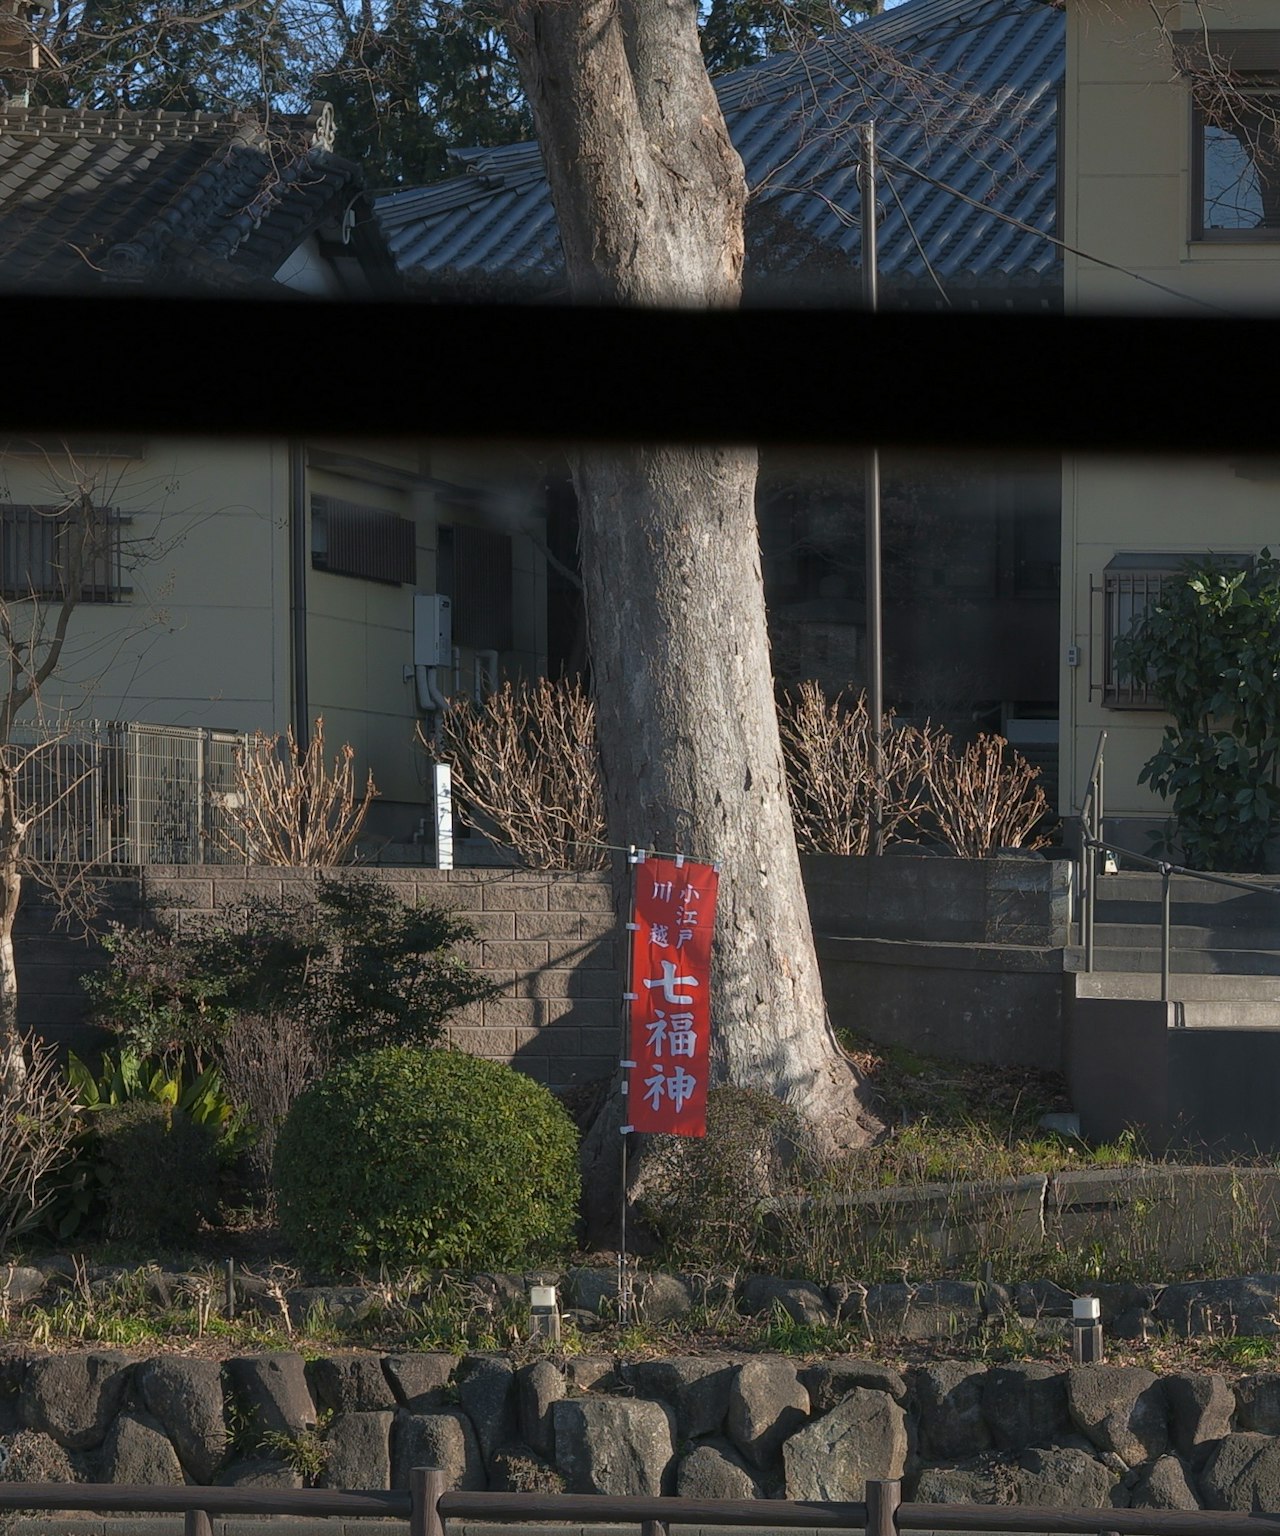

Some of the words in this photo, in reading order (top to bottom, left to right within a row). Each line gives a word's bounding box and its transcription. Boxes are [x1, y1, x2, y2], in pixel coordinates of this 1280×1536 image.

[648, 880, 673, 948] 川越
[675, 883, 700, 949] 小江戸
[643, 959, 699, 1113] 七福神
